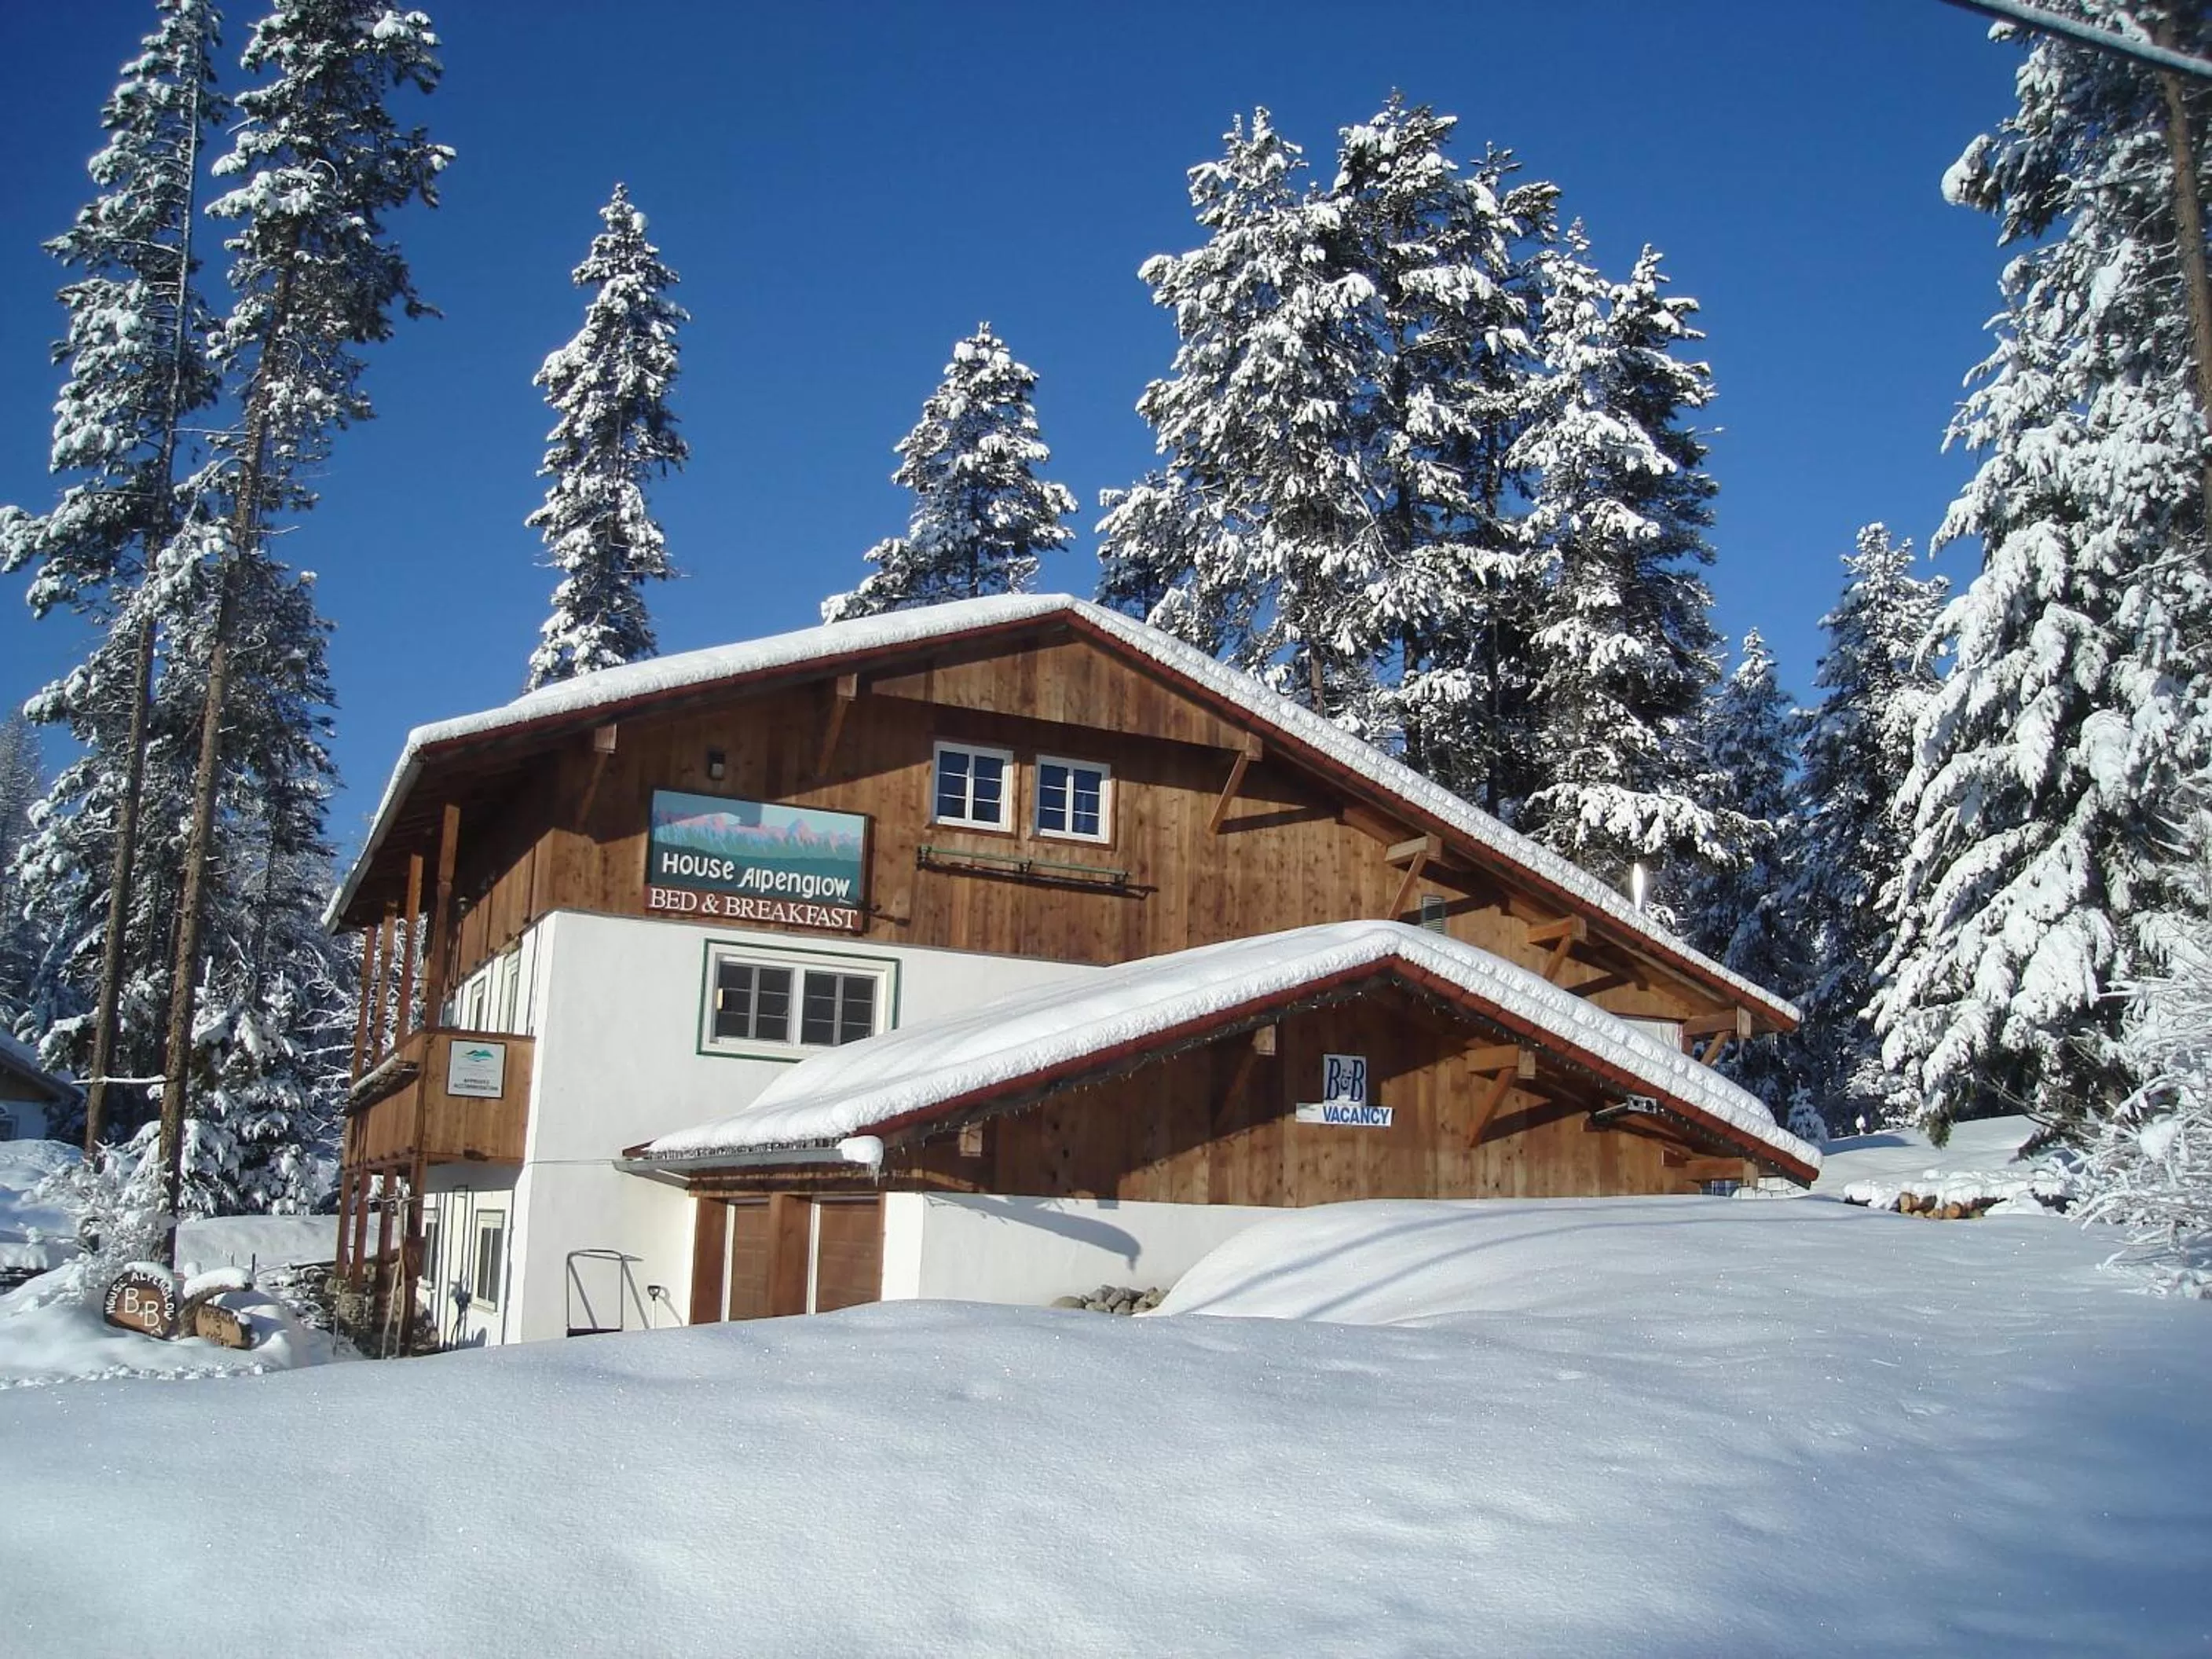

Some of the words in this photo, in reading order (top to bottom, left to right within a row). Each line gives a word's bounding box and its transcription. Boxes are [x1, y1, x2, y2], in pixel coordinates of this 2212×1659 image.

[649, 888, 698, 912] BED
[701, 893, 720, 914] &
[724, 896, 858, 930] BREAKFAST
[1325, 1058, 1365, 1102] B&B
[1322, 1106, 1390, 1125] VACANCY
[104, 1278, 128, 1315] HOUSE
